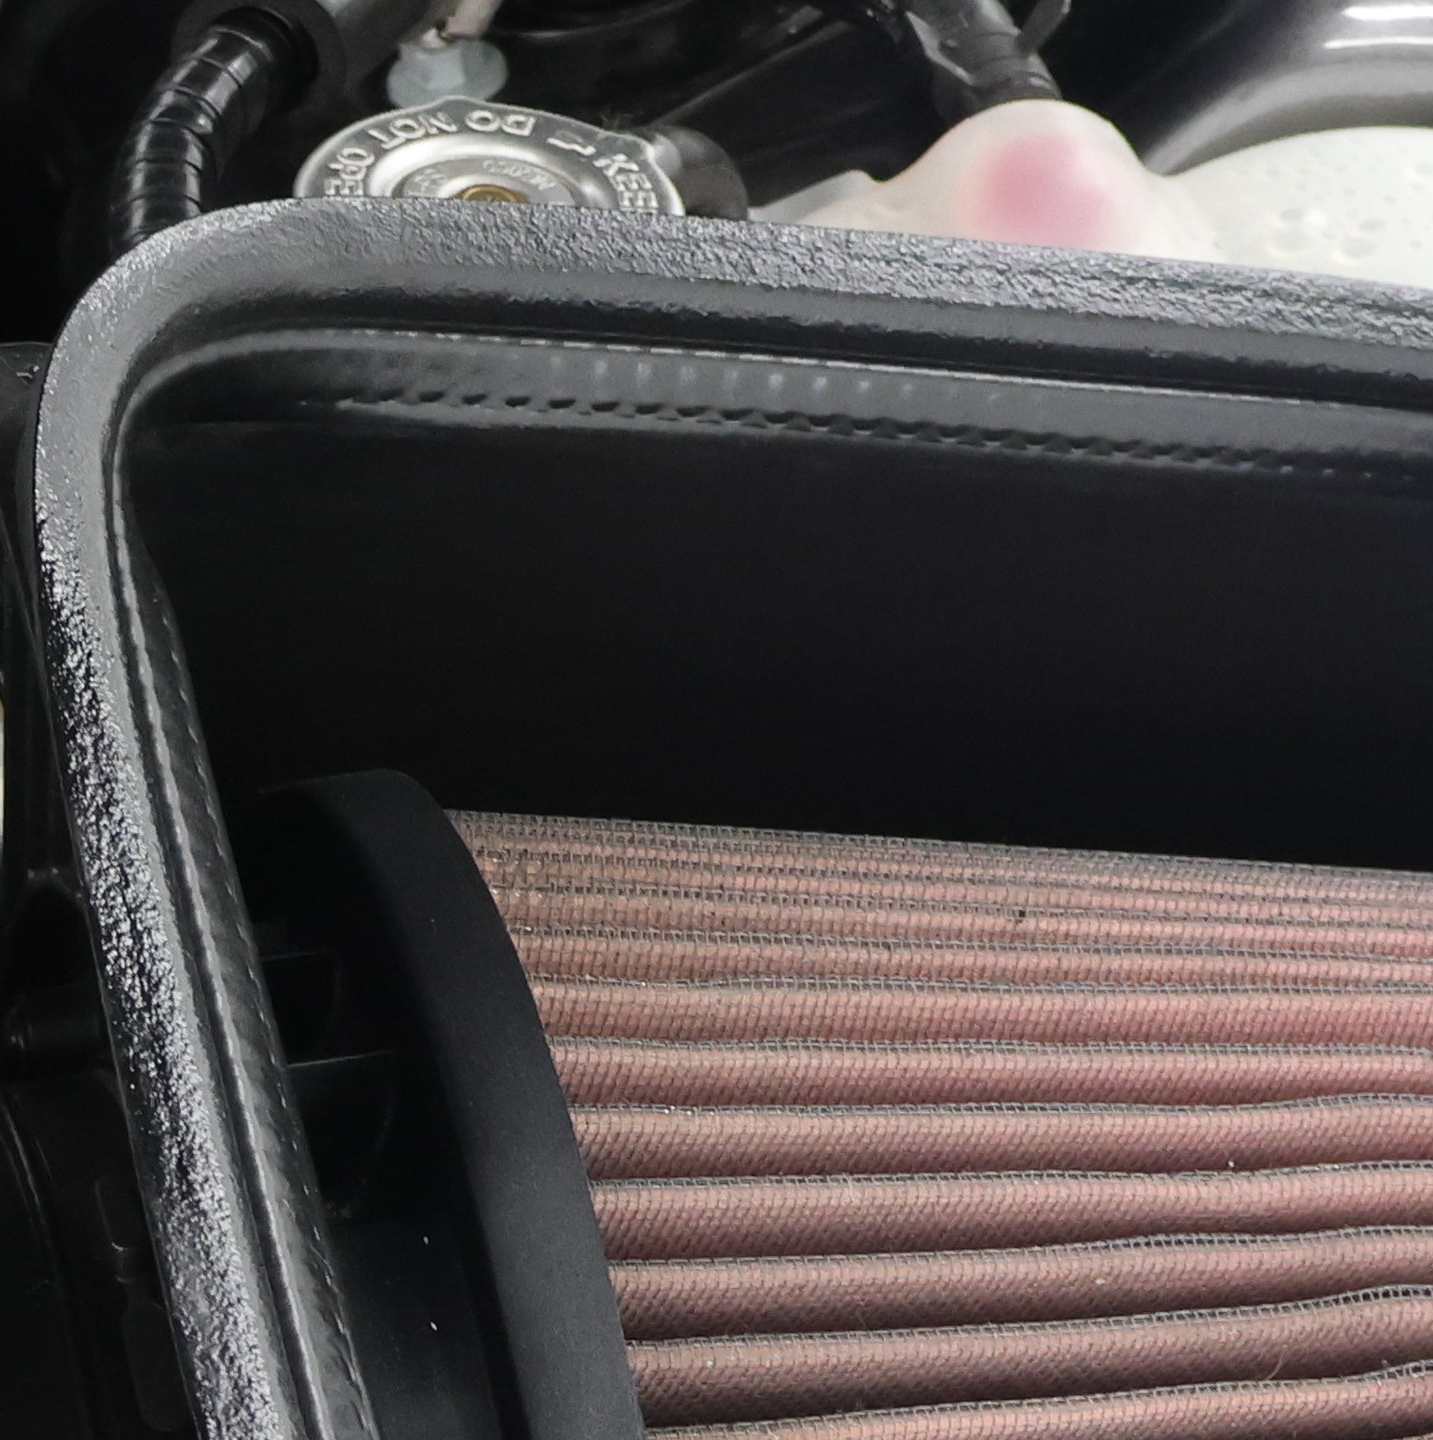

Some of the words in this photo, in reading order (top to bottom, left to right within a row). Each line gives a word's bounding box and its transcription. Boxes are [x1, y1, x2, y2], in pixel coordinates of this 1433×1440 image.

[368, 111, 458, 150] NOT
[465, 110, 537, 137] DO
[324, 147, 375, 197] OPE
[592, 153, 660, 213] KEE
